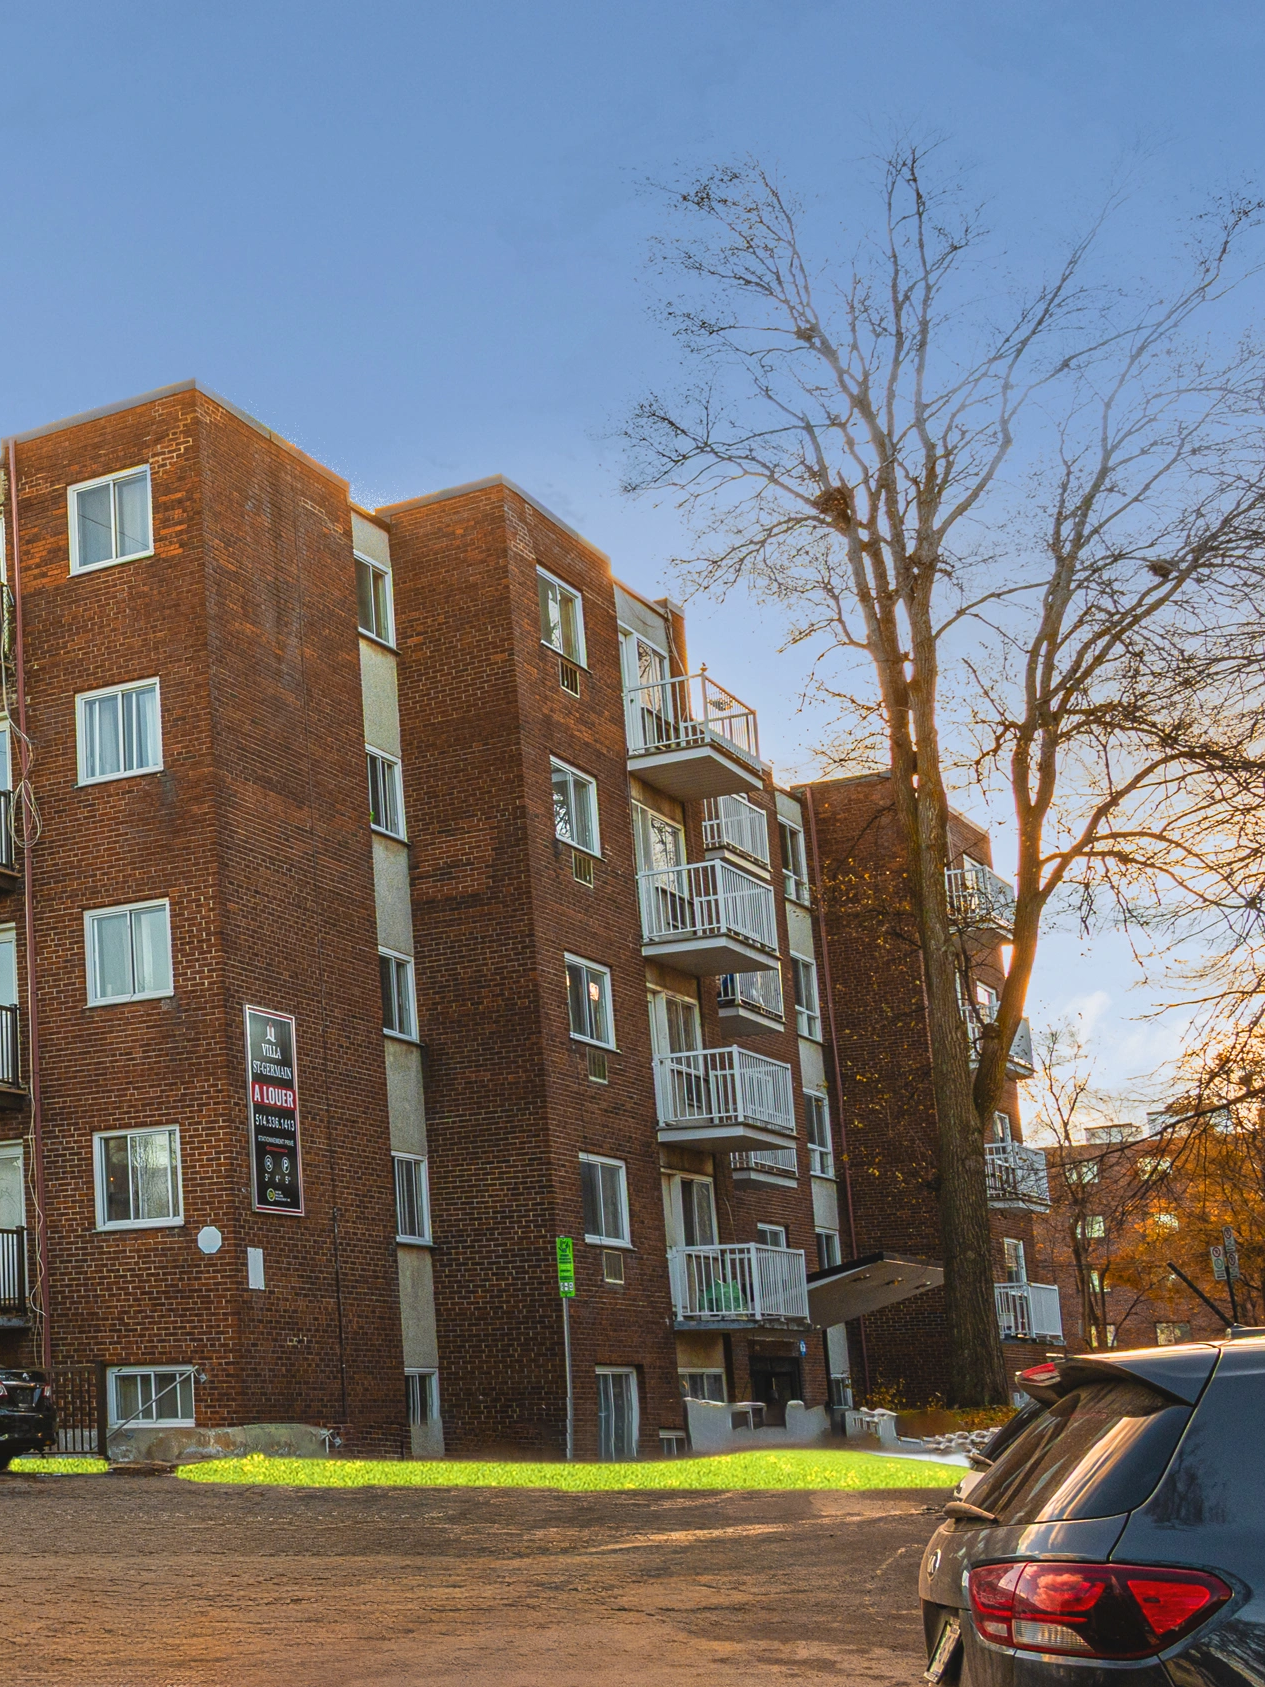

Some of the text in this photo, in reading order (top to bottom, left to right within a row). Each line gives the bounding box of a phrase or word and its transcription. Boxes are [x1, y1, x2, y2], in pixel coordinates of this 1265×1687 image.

[261, 1043, 282, 1060] VILLA
[252, 1060, 292, 1080] ST-GERMAIN
[263, 1085, 294, 1108] LOUER
[255, 1113, 295, 1131] 514.336.1413
